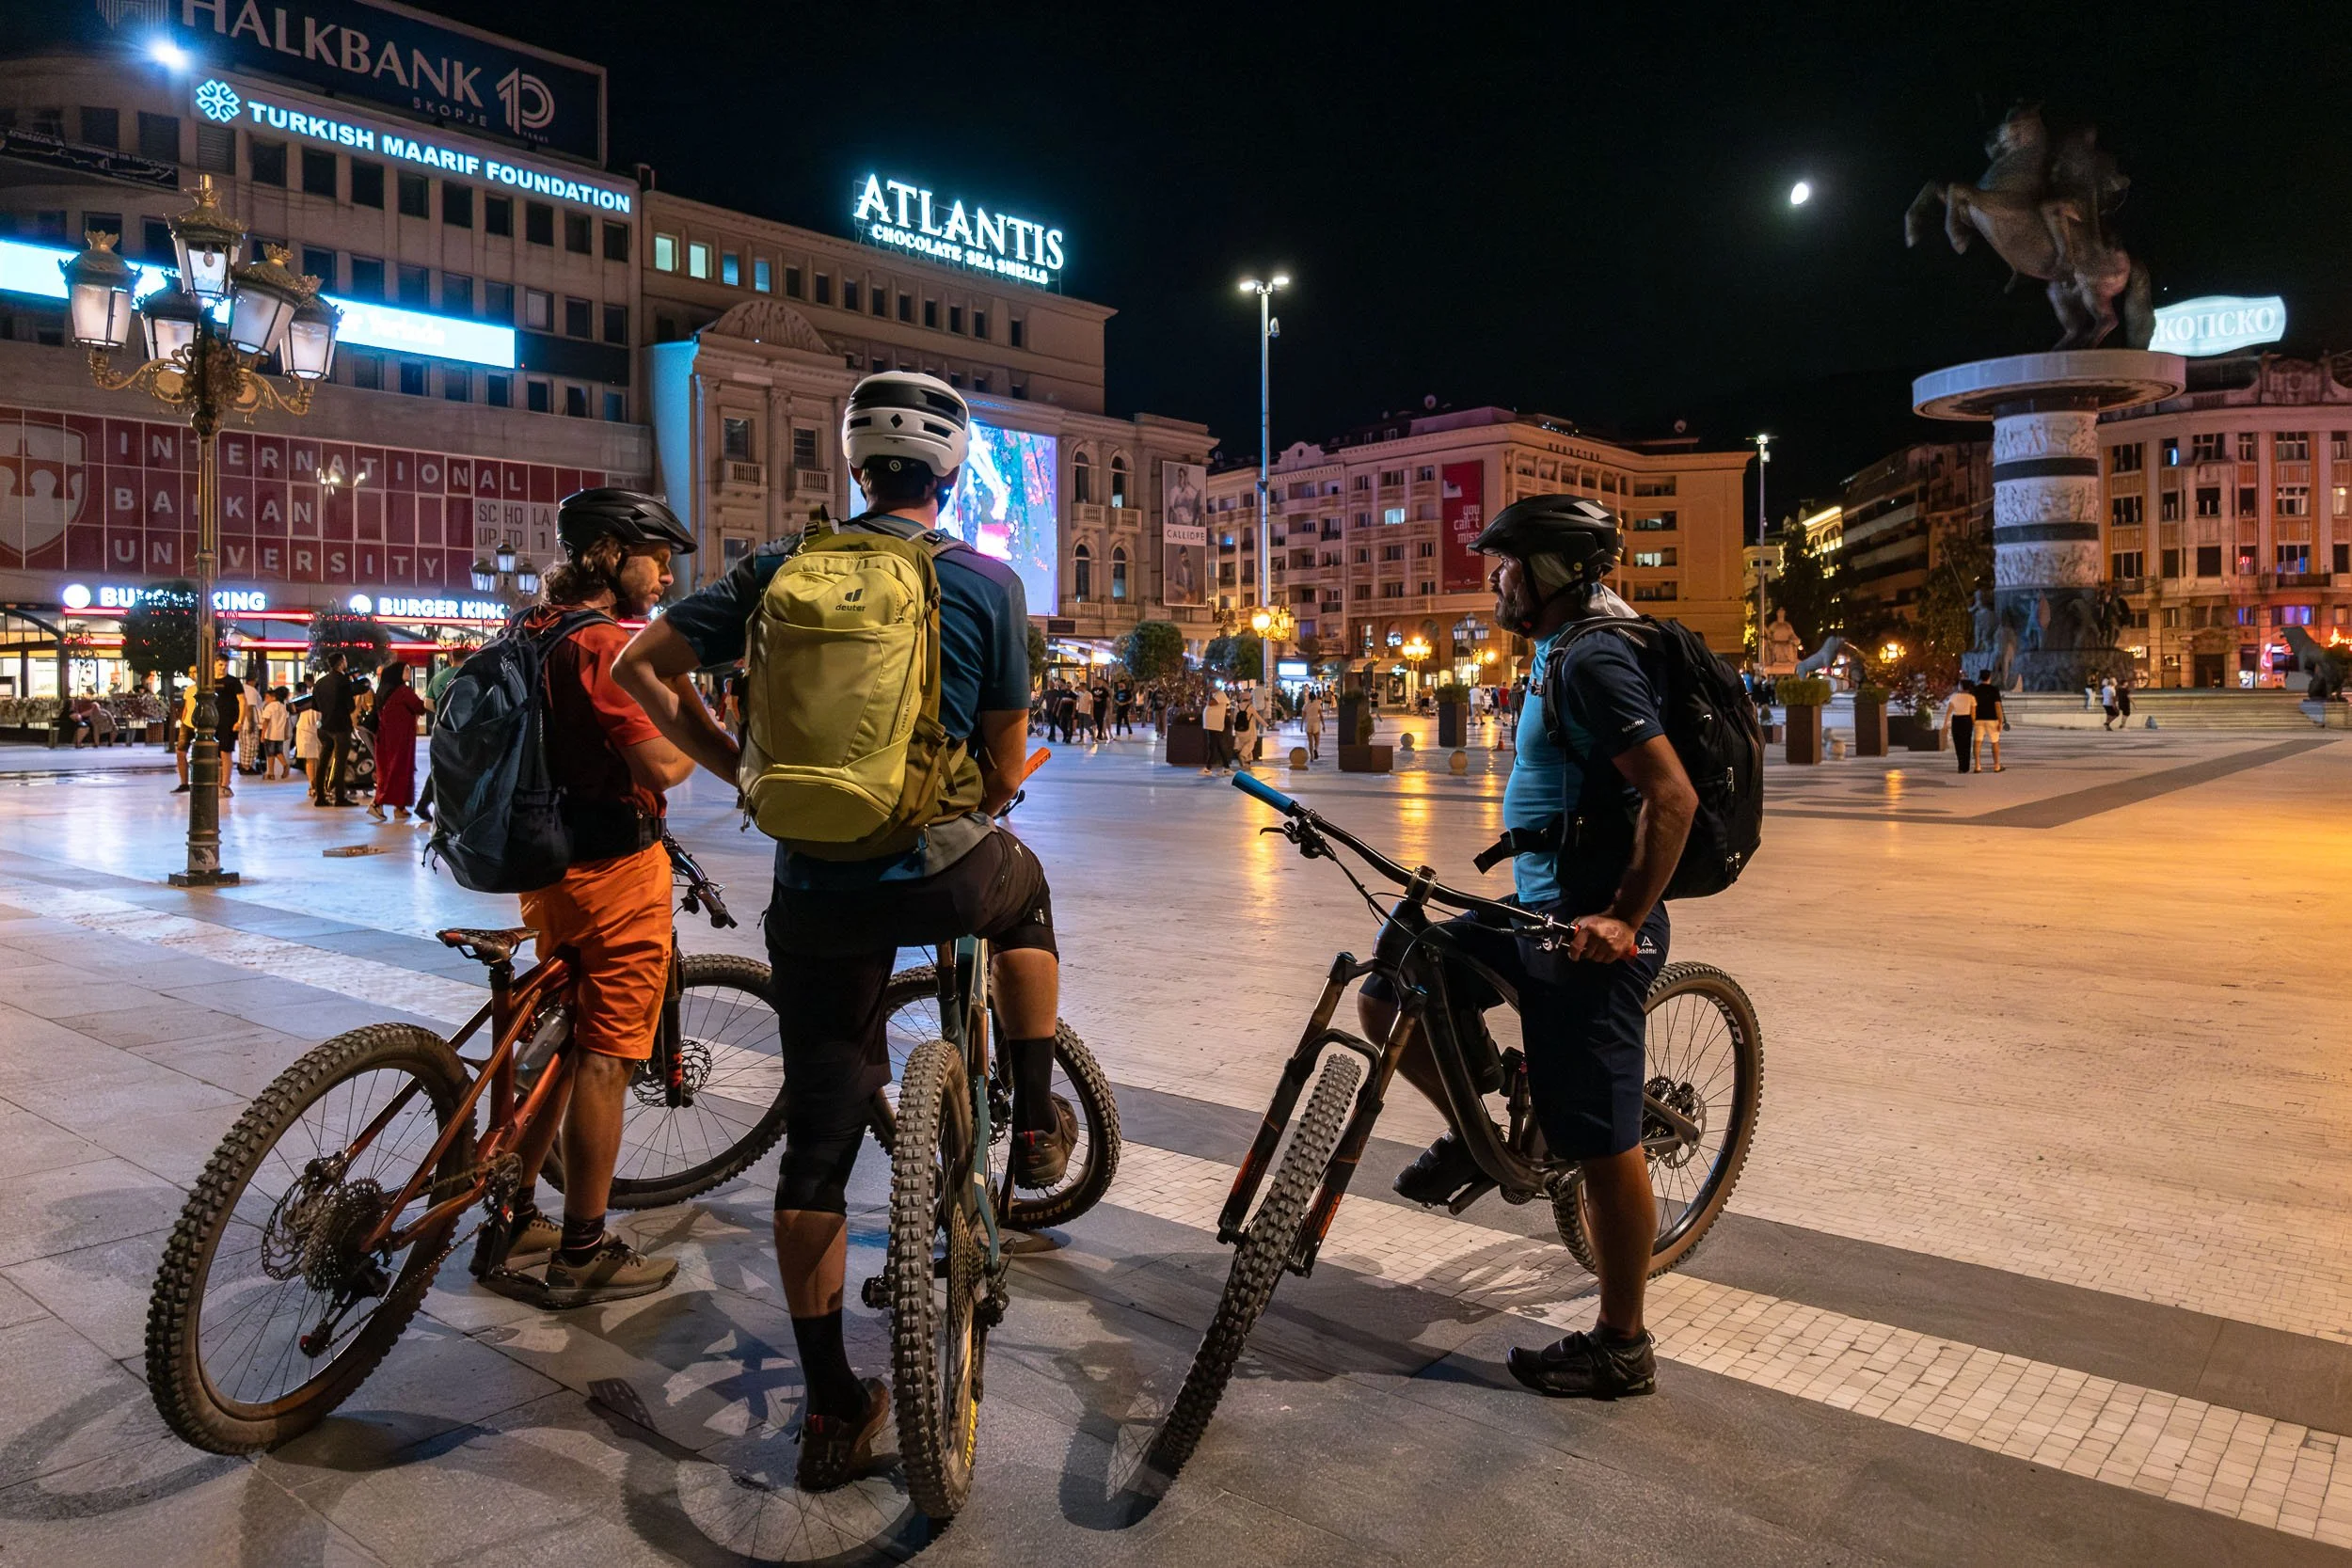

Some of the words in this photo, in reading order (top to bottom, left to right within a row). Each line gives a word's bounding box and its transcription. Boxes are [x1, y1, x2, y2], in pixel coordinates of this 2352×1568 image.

[183, 0, 484, 108] HALKBANK
[412, 96, 488, 127] SKOPJE
[247, 101, 374, 150] TURKISH
[382, 135, 479, 175] MAARIF
[485, 161, 631, 214] FOUNDATION
[852, 173, 1065, 271] ATLANTIS
[870, 223, 963, 262] CHOCOLATE
[965, 248, 996, 272] SEA
[995, 258, 1050, 285] SHELLS
[2157, 307, 2277, 343] КОПСКО
[478, 502, 552, 528] SCHOLA
[1463, 504, 1480, 516] you
[478, 527, 498, 546] UP
[1167, 529, 1205, 541] CALLIOPE
[114, 539, 439, 578] UNVERSITY
[379, 597, 459, 618] BURGER
[834, 603, 866, 612] deuter
